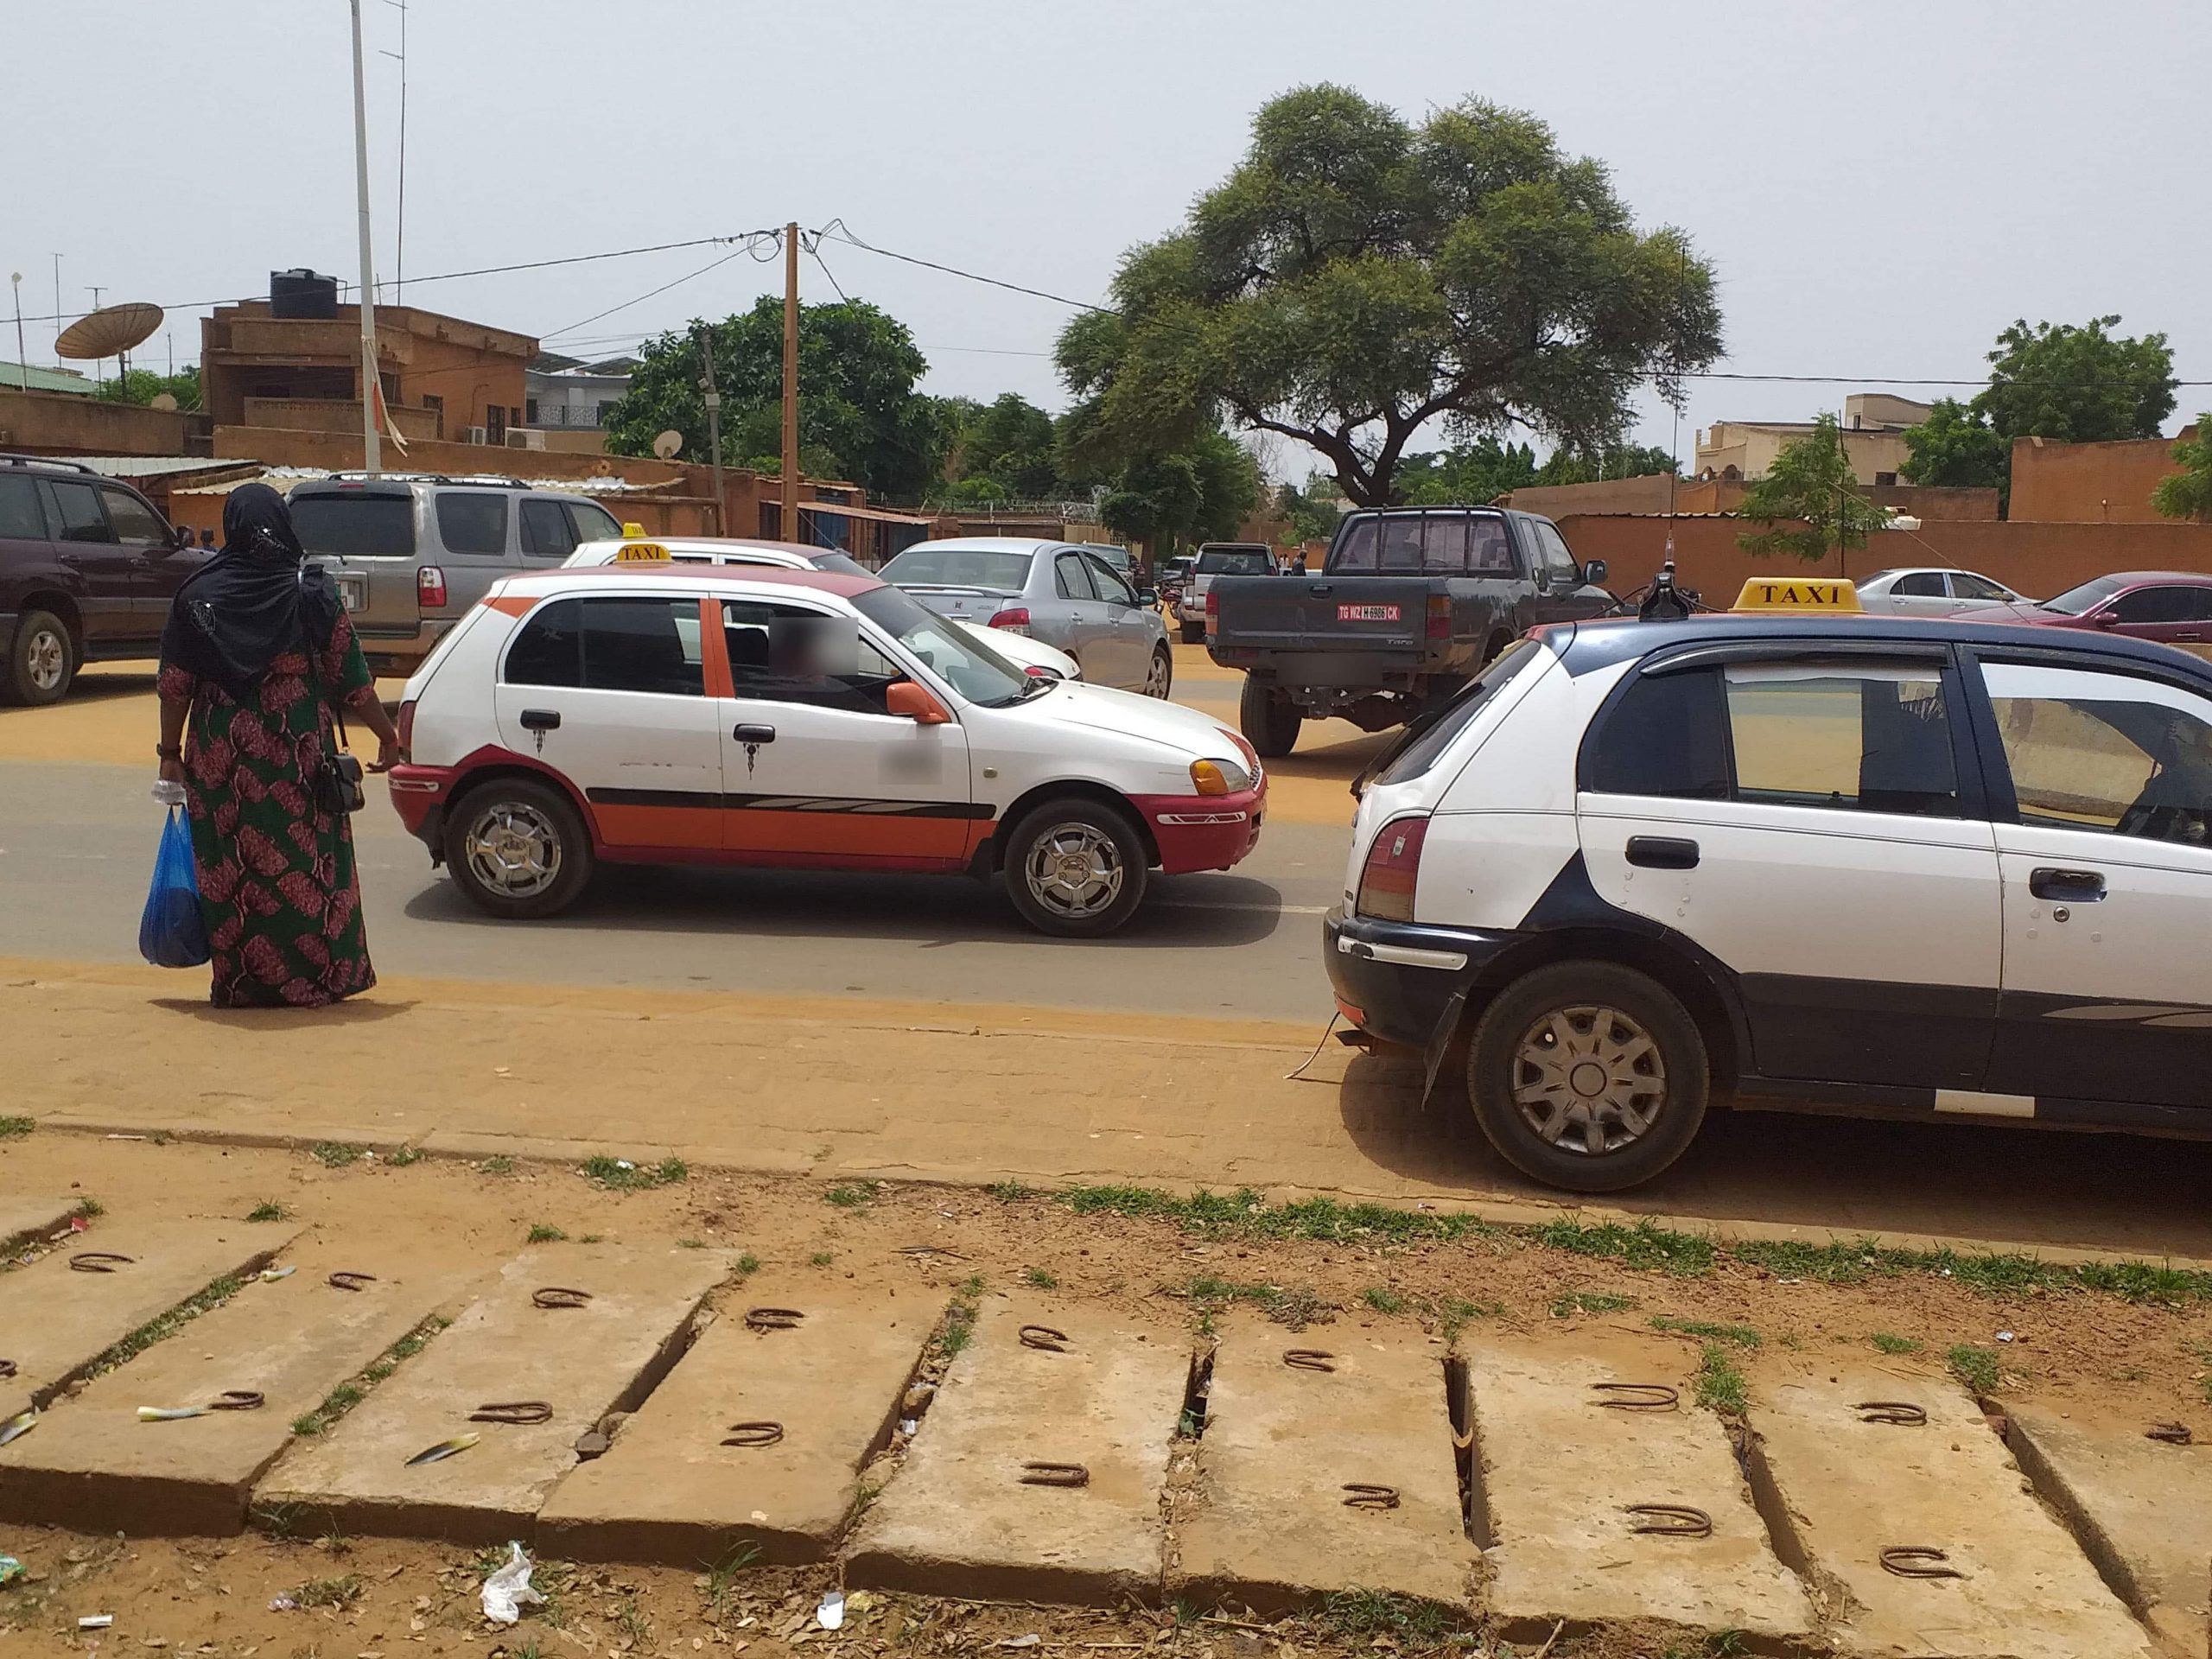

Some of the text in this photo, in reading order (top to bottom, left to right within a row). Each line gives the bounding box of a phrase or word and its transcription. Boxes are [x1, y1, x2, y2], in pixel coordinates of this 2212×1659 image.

[624, 547, 661, 561] TAXI
[1760, 585, 1840, 604] TAXI
[1339, 606, 1349, 620] TG
[1387, 607, 1398, 620] CK
